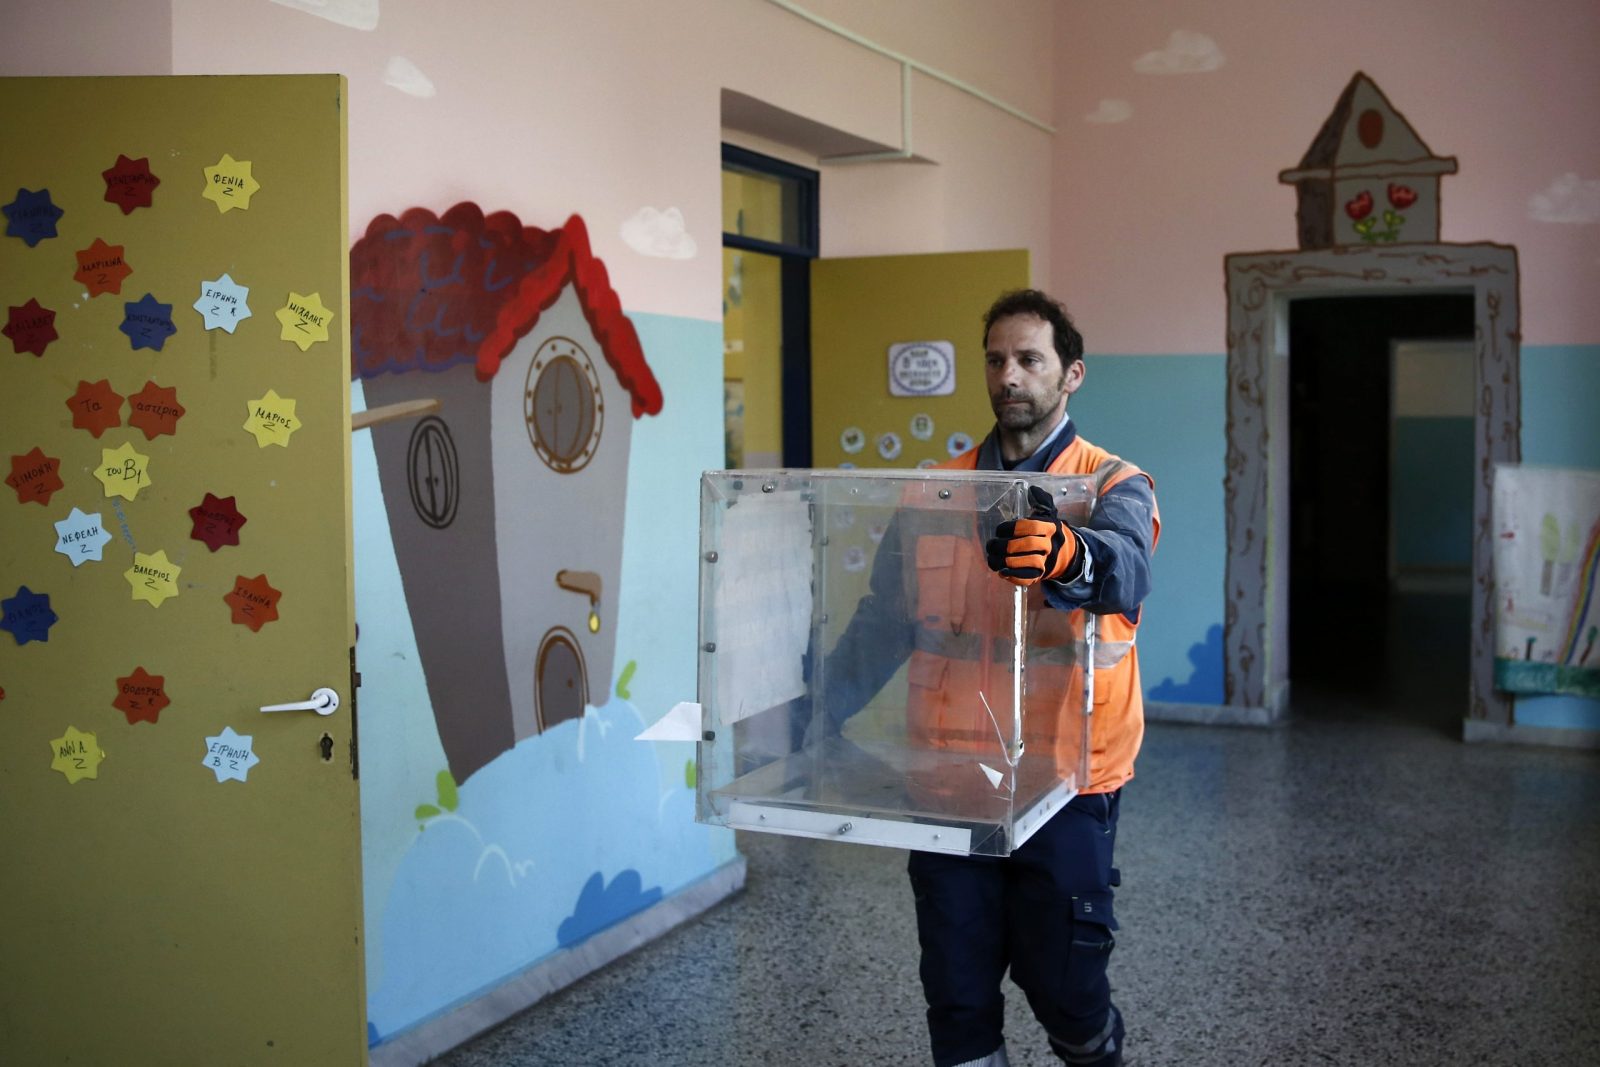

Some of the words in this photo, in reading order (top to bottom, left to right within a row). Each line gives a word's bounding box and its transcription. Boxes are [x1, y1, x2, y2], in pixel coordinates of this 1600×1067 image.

[213, 174, 244, 189] ΦΕΝΙΑ
[205, 289, 237, 305] ΕΙΡΗΝΗ
[288, 302, 324, 328] ΜΙΧΑΛΗΣ
[80, 399, 102, 413] Τα
[136, 401, 179, 420] αστέρια
[255, 407, 292, 429] ΜΑΡΙΟΣ
[105, 467, 122, 477] του
[62, 525, 99, 545] ΝΕΦΕΛΗ
[209, 742, 250, 761] ΕΙΡΗΝΗ
